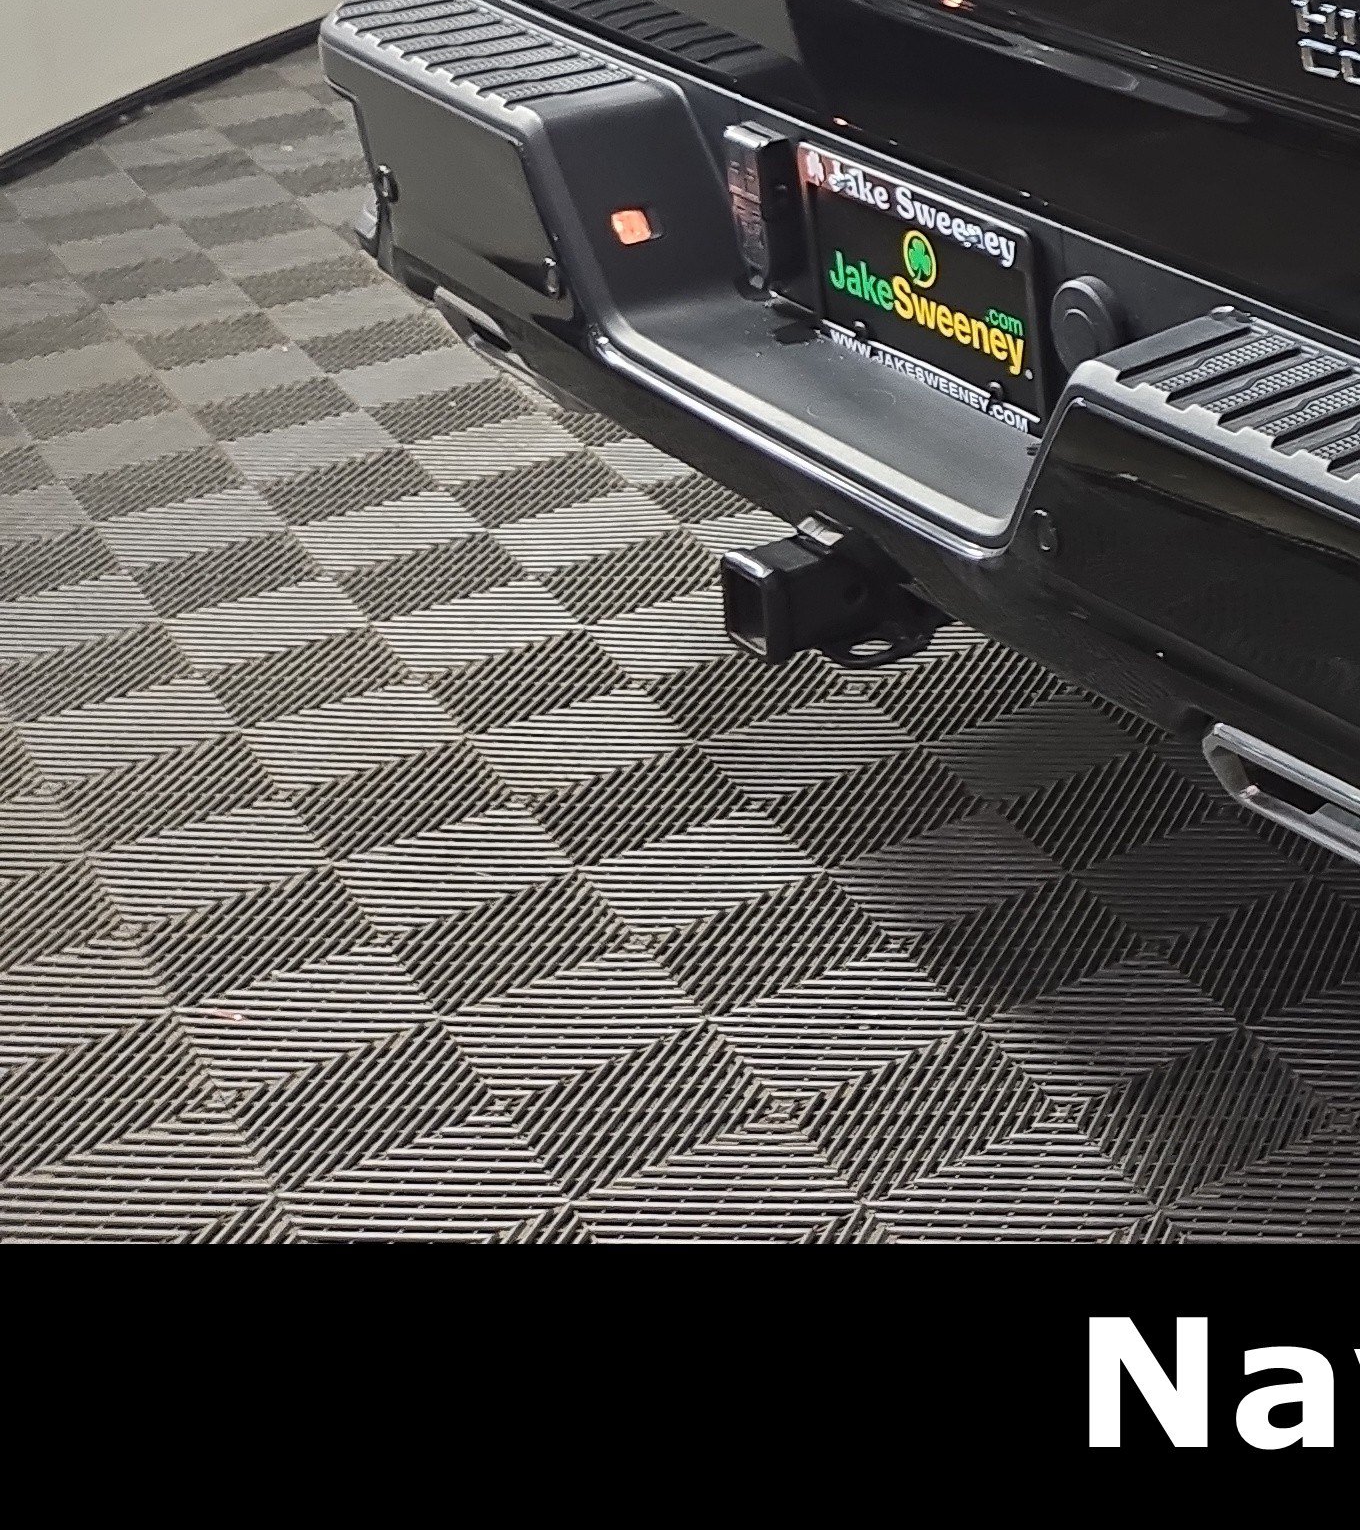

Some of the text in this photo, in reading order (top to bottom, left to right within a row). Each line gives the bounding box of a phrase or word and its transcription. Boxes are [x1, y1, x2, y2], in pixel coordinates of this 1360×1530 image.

[828, 159, 1015, 267] Jake Sweeney
[829, 250, 1025, 375] JakeSweeney
[829, 328, 1029, 433] WWW.JAKESWEENEY.COM
